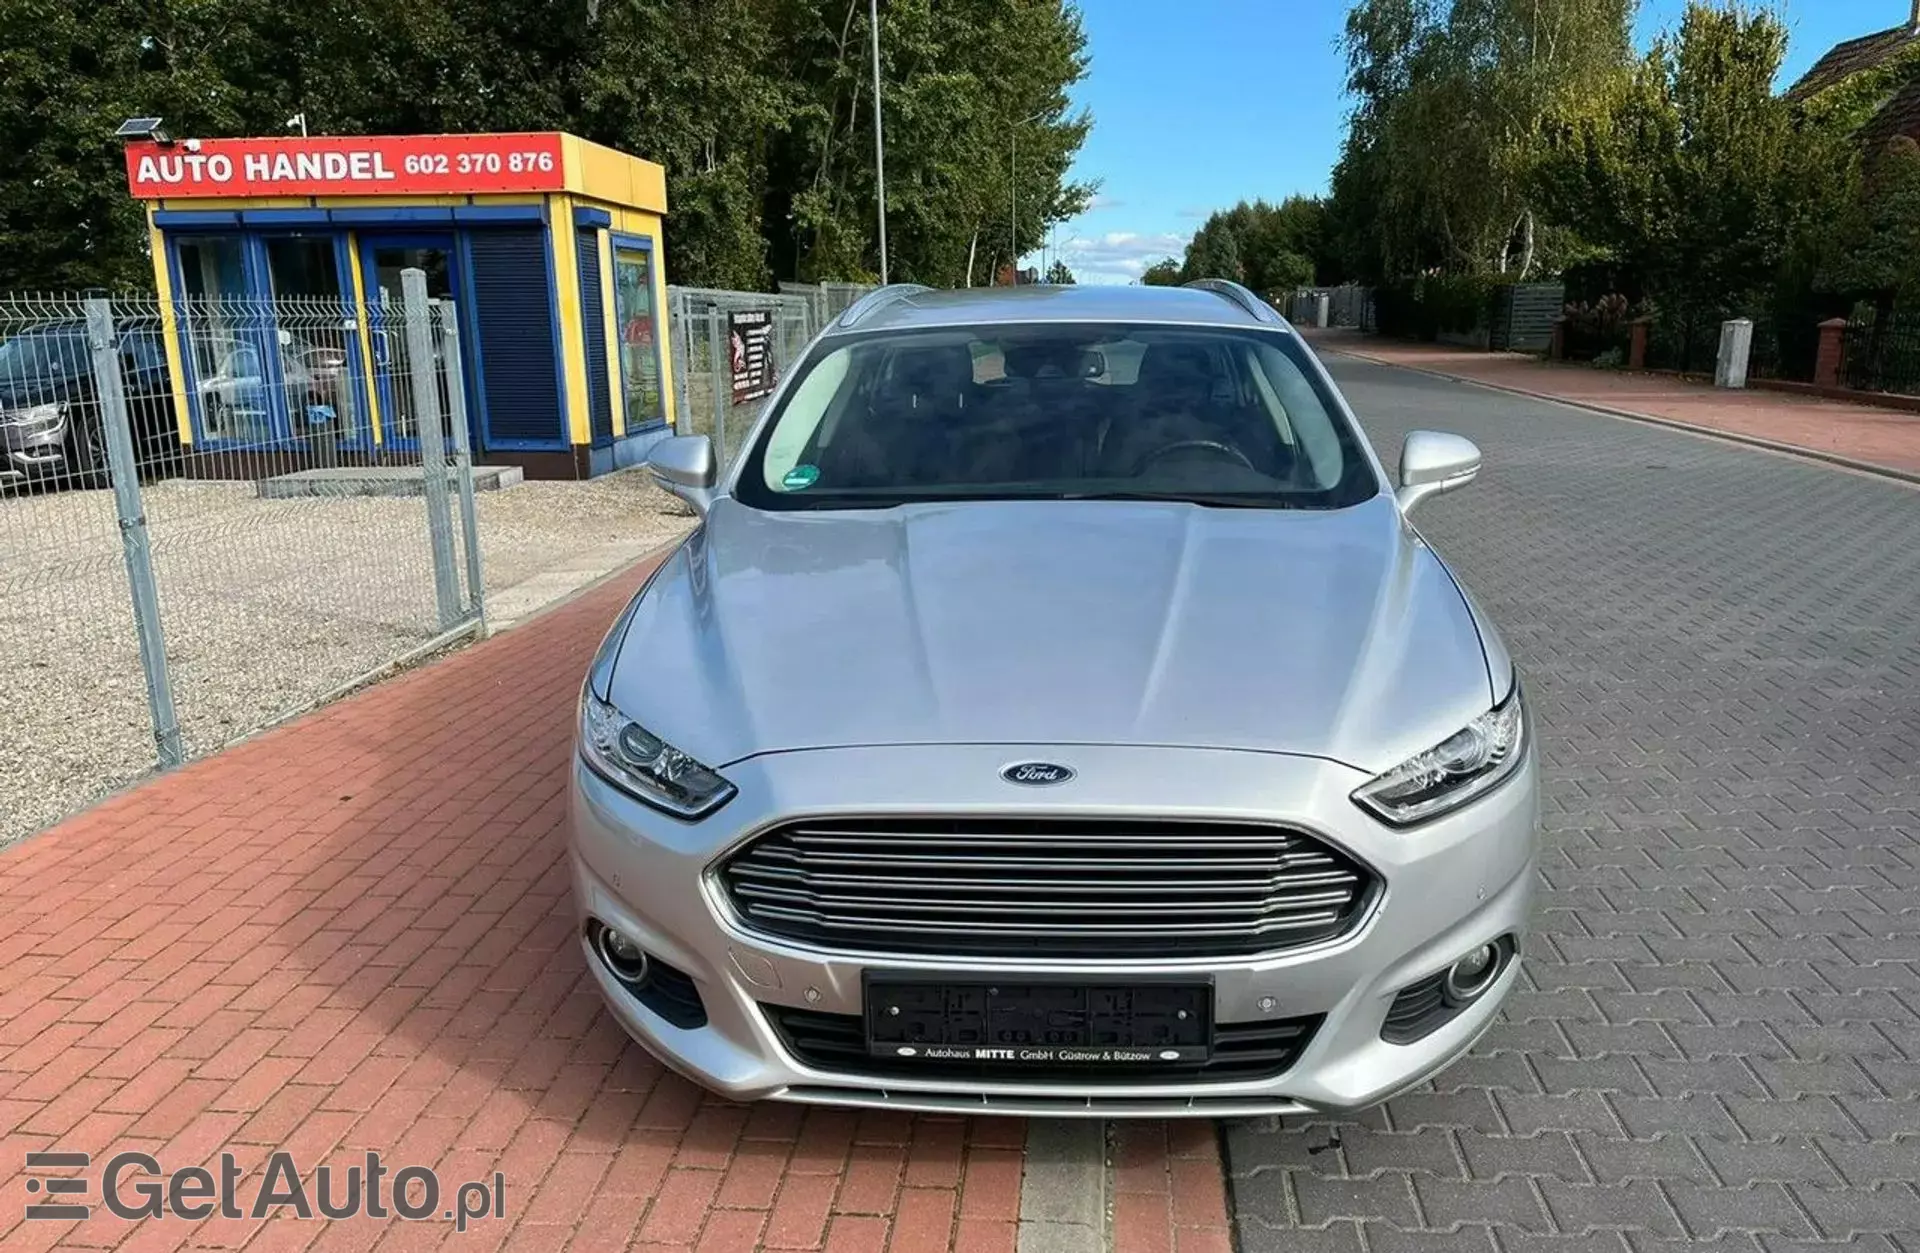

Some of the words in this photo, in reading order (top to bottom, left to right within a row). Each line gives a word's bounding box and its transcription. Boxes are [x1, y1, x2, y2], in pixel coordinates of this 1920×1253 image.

[137, 154, 233, 183] AUTO
[243, 151, 395, 181] HANDEL
[404, 154, 449, 174] 602
[456, 153, 501, 173] 370
[508, 152, 554, 172] 876
[1016, 765, 1058, 780] Ford
[925, 1048, 970, 1058] Autohaus
[975, 1049, 1015, 1059] MITTE
[1020, 1050, 1053, 1060] GmbH
[1059, 1050, 1100, 1061] Güstrow
[1102, 1051, 1110, 1060] &
[1114, 1051, 1151, 1061] Bützow
